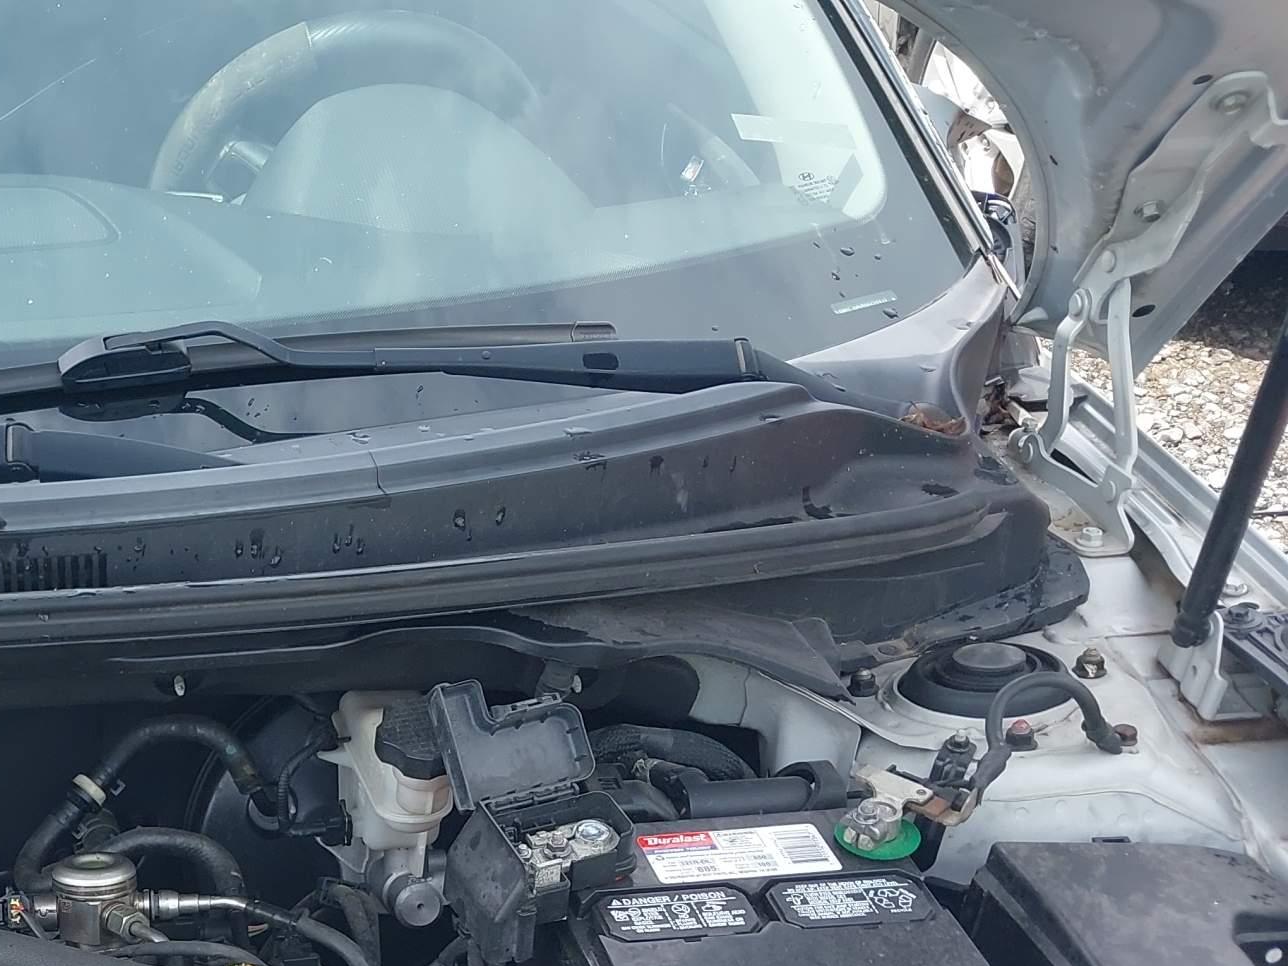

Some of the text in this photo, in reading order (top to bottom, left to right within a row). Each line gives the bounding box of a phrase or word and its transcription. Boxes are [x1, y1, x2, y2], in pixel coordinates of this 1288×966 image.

[646, 833, 707, 847] Duralast
[621, 895, 671, 906] DANGER
[681, 891, 726, 901] POISON
